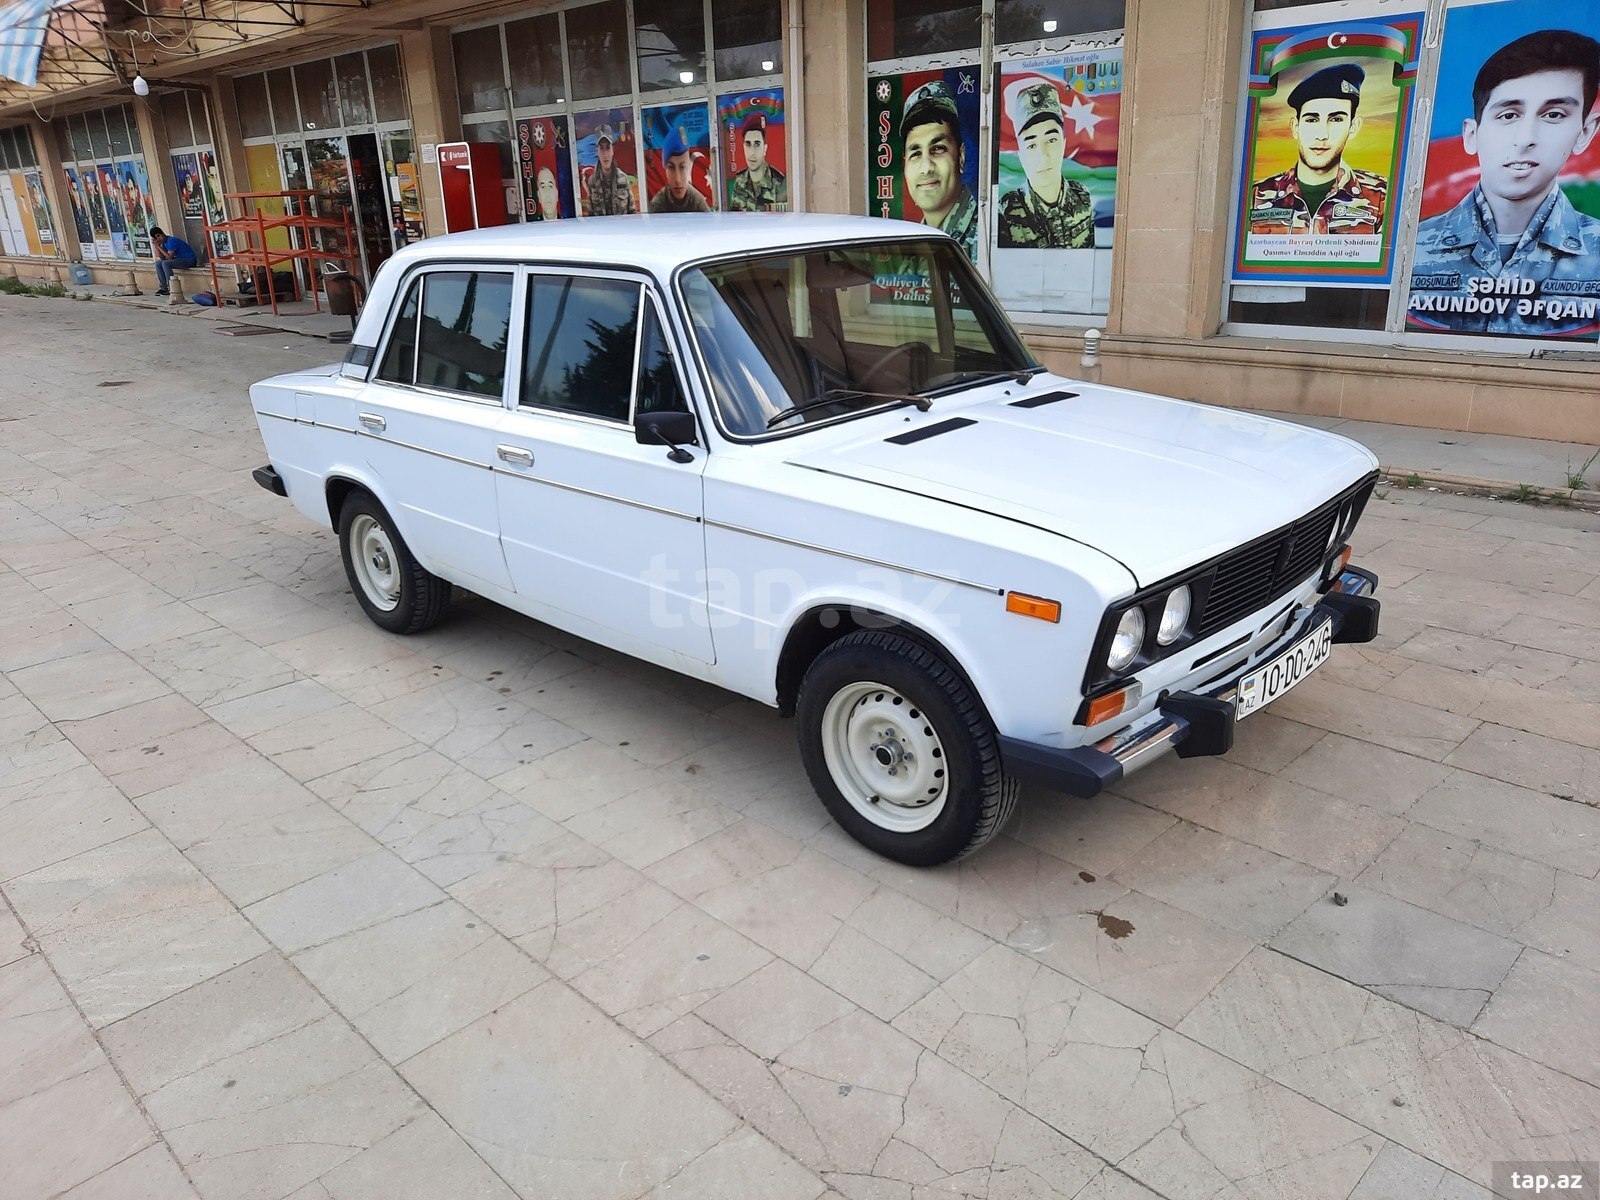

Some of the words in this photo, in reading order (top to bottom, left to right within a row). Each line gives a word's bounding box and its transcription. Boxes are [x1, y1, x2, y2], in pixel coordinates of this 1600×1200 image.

[1046, 57, 1061, 66] Sabir
[1288, 239, 1313, 247] Bayraq
[1343, 239, 1379, 247] Şəhidimiz
[1327, 249, 1343, 258] Aqil
[1344, 250, 1360, 258] oğlu
[876, 276, 919, 291] Quliyev
[1543, 281, 1584, 292] AXUNDOV
[1407, 294, 1511, 316] AXUNDOV
[1516, 298, 1597, 321] ƏFQAN
[1261, 626, 1331, 702] 10-DO-246
[1244, 695, 1256, 711] AZ
